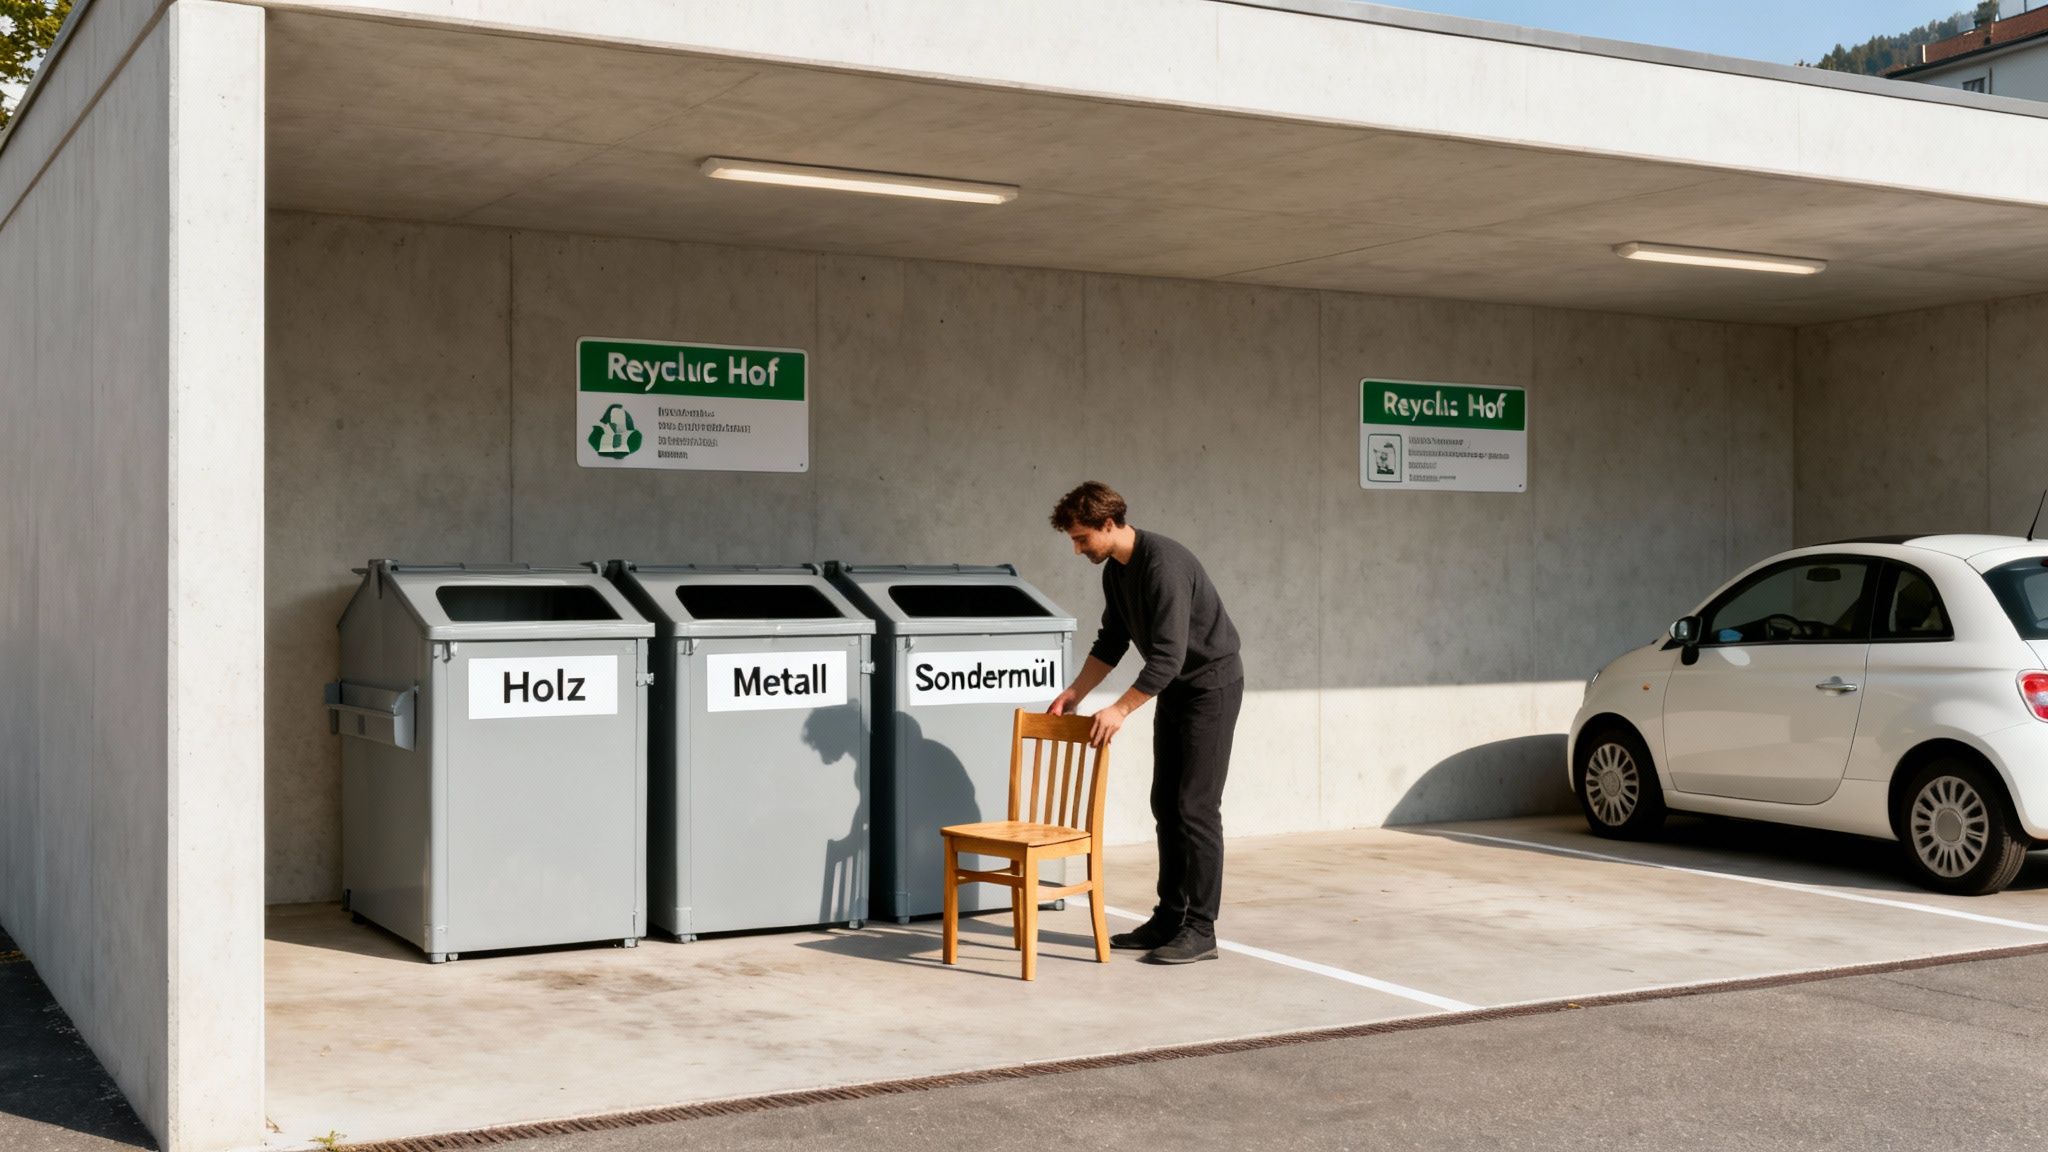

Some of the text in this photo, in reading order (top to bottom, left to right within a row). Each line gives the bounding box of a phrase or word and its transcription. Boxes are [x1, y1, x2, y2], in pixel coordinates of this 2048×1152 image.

[728, 355, 780, 387] Hof
[1468, 392, 1508, 419] Hof
[503, 668, 586, 704] Holz
[733, 663, 827, 697] Metall
[915, 658, 1055, 691] Sondermül
